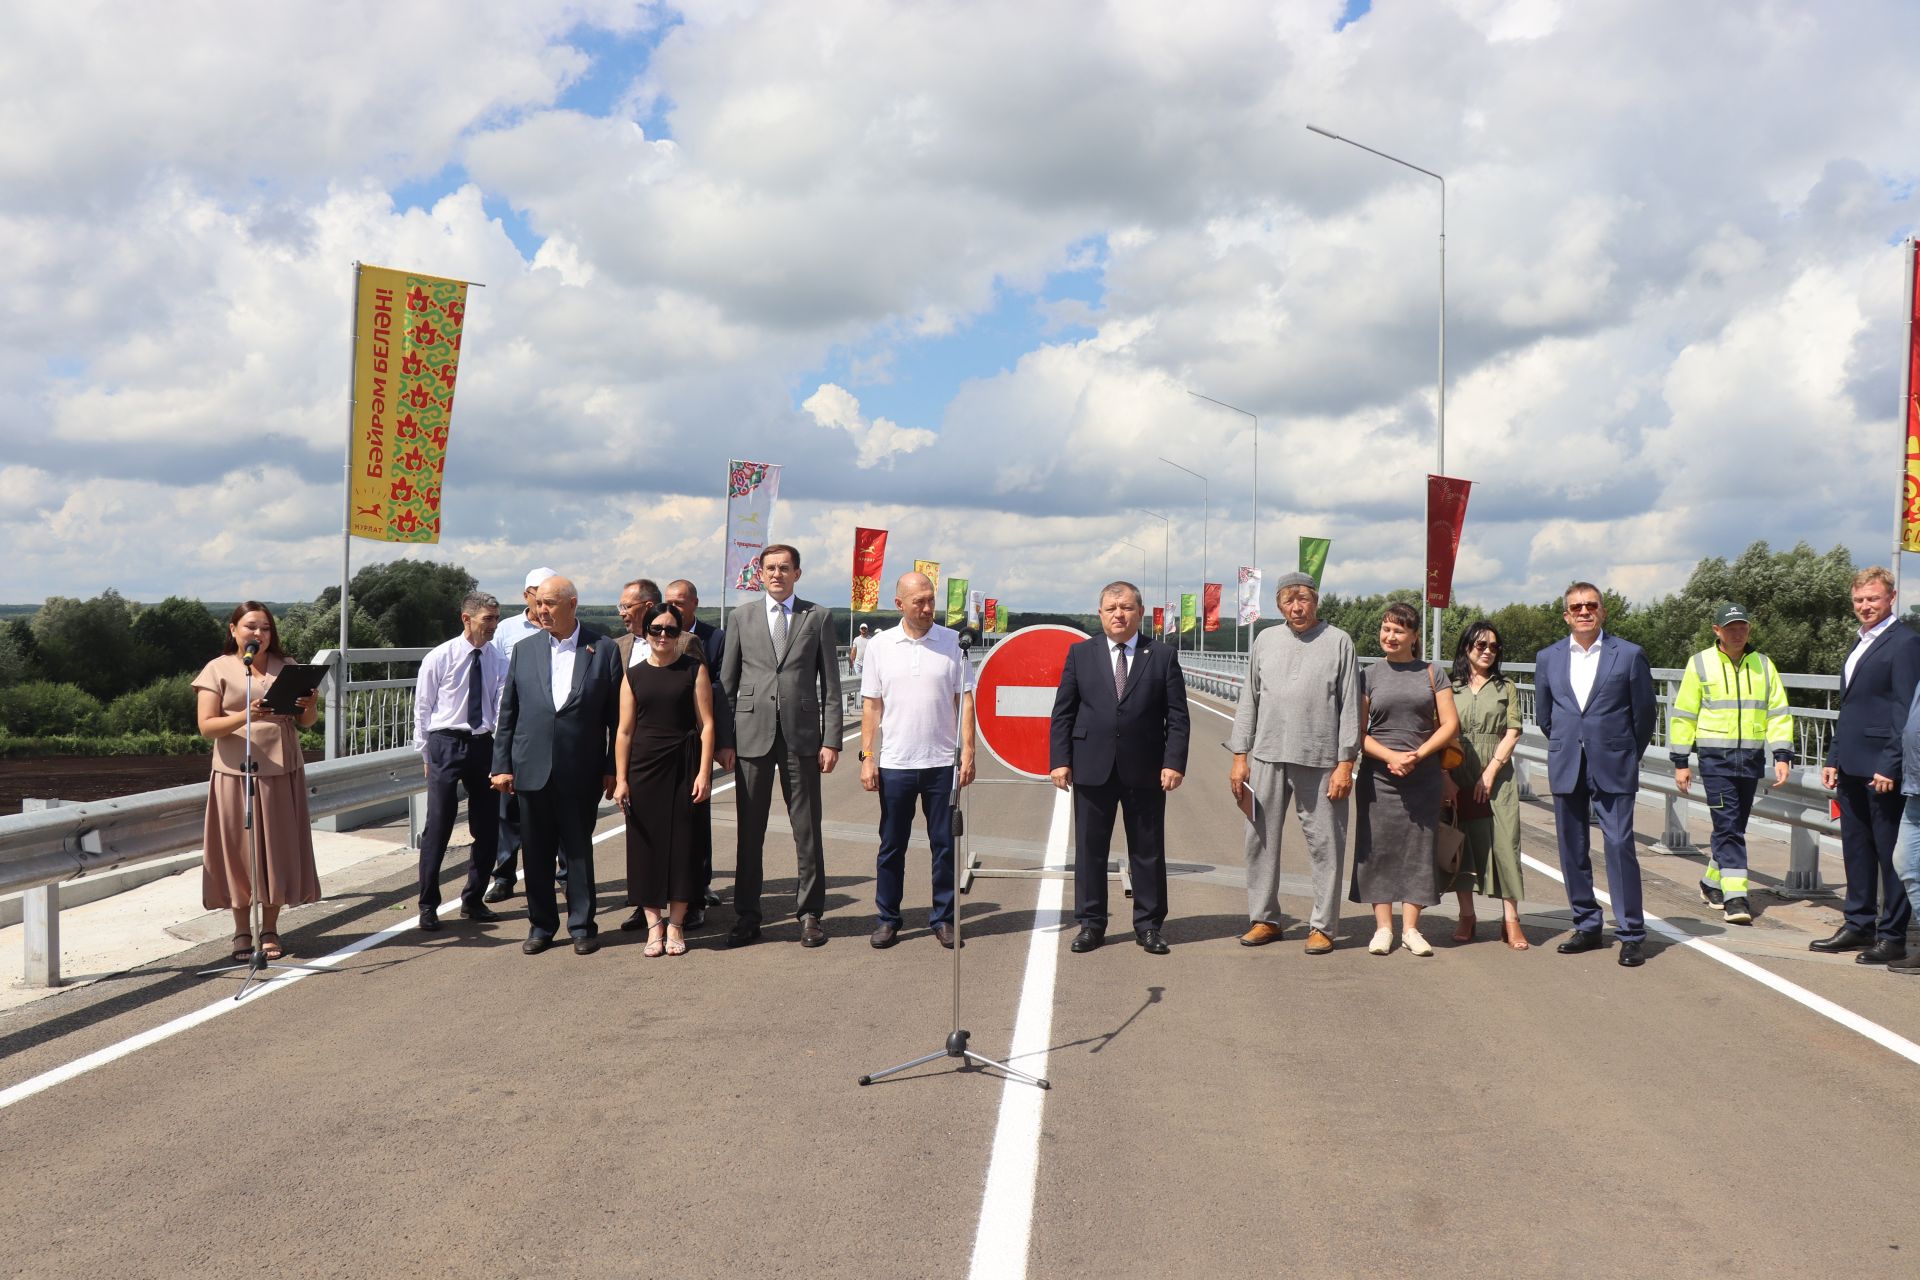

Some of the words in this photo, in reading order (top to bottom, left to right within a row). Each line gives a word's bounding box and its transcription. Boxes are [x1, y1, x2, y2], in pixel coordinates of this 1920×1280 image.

[374, 288, 394, 374] БЕЛӘН!
[367, 377, 387, 479] БӘЙРӘМ
[354, 523, 383, 534] НУРЛАТ
